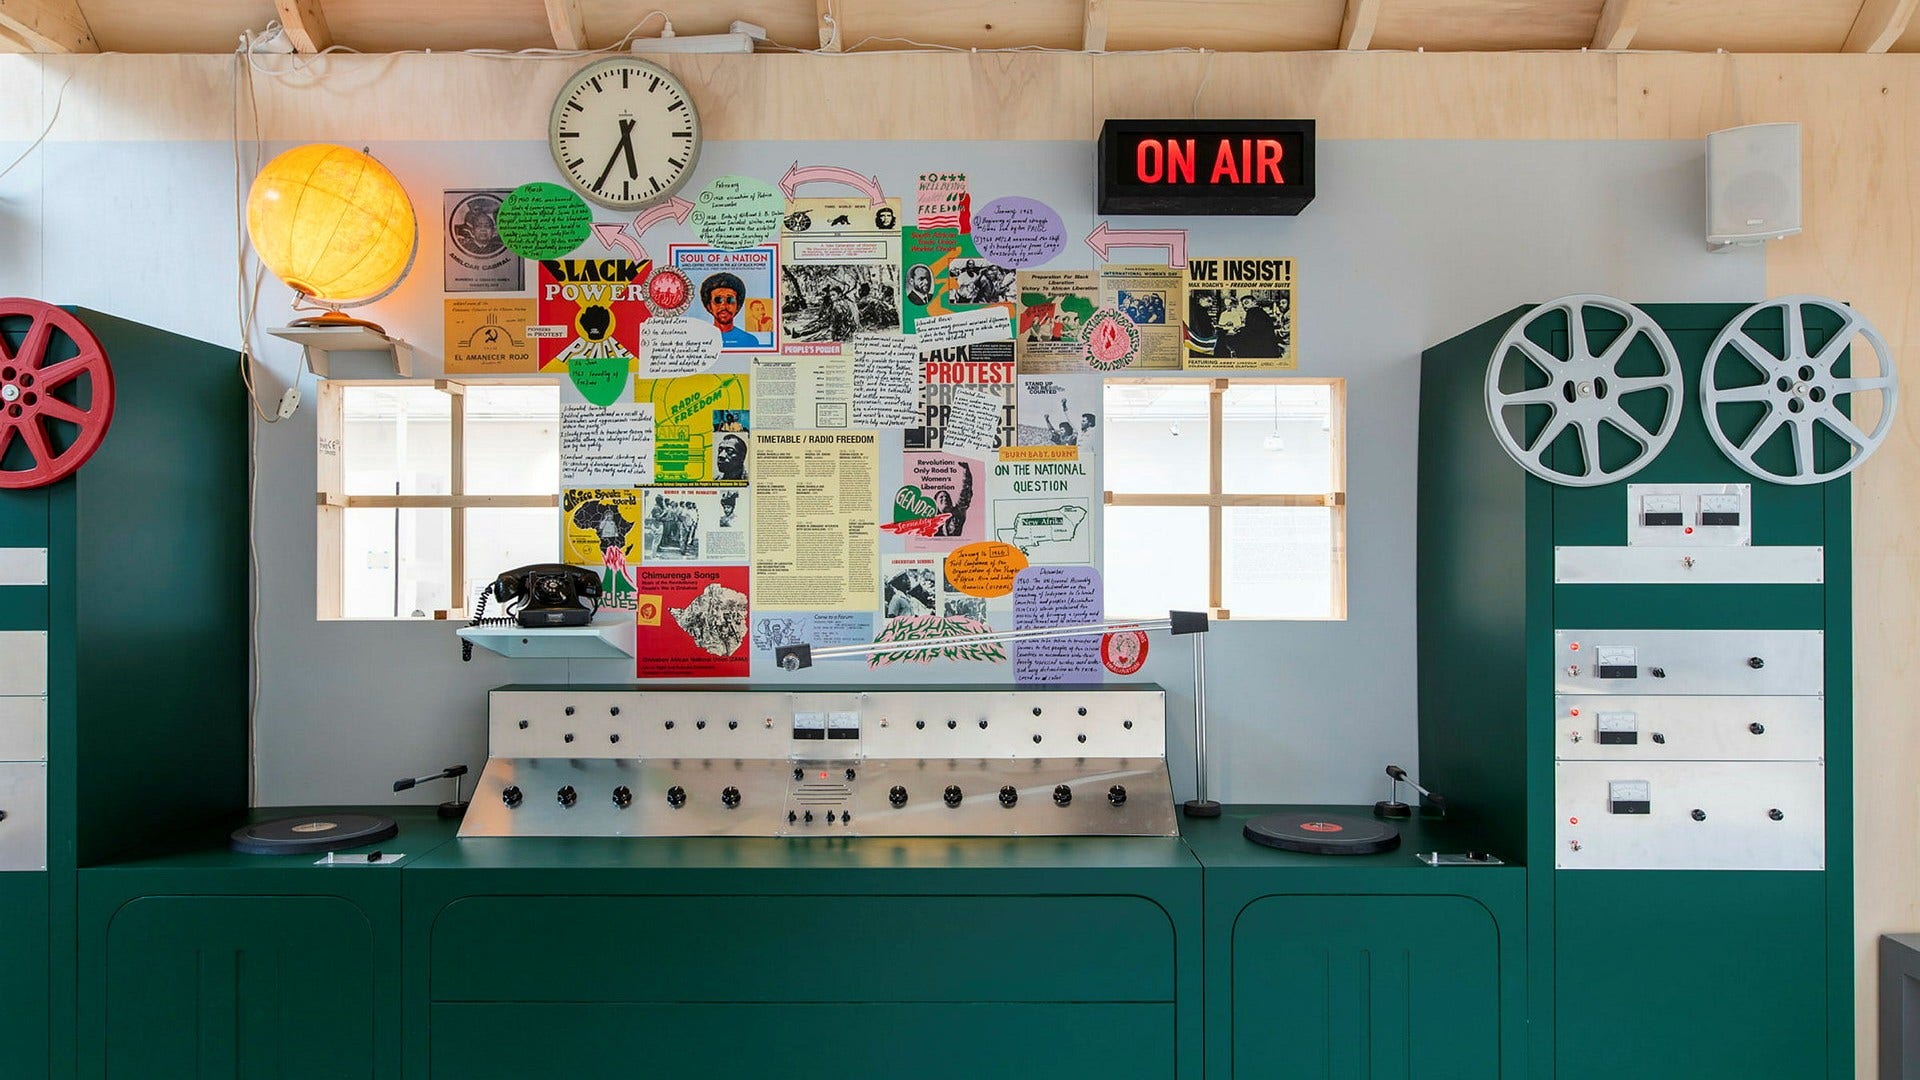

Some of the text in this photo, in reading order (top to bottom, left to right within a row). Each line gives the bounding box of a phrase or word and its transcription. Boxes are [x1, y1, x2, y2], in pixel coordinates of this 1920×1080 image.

[1136, 138, 1285, 184] ON AIR
[680, 254, 768, 263] SOUL OF A NATION
[540, 259, 650, 282] BLACK
[1189, 260, 1291, 281] WE INSIST!
[544, 283, 645, 301] POWER
[784, 346, 840, 354] PEOPLE'S POWER
[919, 344, 968, 363] LACK
[926, 362, 1015, 384] PROTEST
[670, 392, 701, 415] RADIO
[674, 389, 723, 424] FREEDOM
[757, 435, 874, 444] TIMETABLE / RADIO FREEDOM
[994, 463, 1086, 476] ON THE NATIONAL
[1013, 480, 1068, 494] QUESTION
[895, 487, 936, 518] GENDER
[641, 571, 720, 580] Chimurenga Songs
